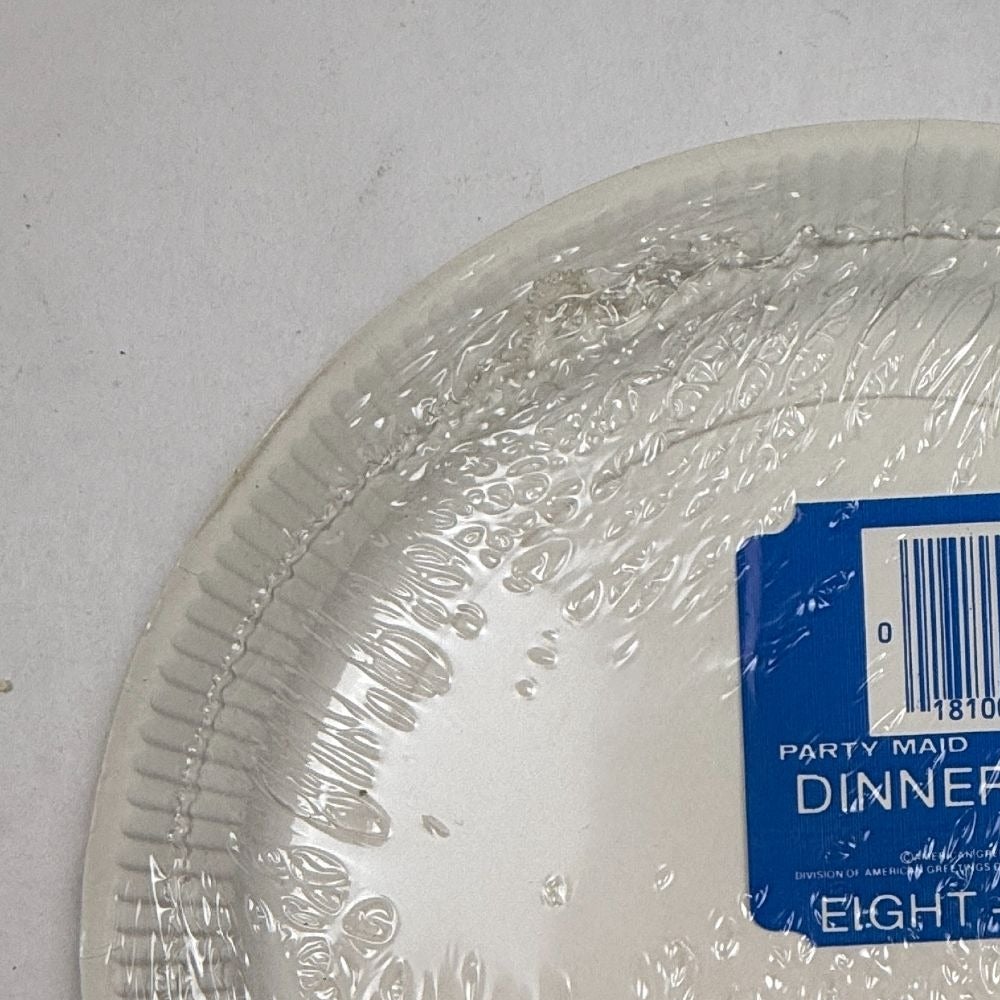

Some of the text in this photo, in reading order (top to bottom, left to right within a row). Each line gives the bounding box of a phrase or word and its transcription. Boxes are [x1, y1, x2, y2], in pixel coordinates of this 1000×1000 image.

[877, 621, 893, 644] 0
[779, 736, 968, 760] PARTY MAID
[795, 870, 843, 881] DIVISION
[846, 869, 859, 878] OF
[821, 891, 977, 933] EIGHT
